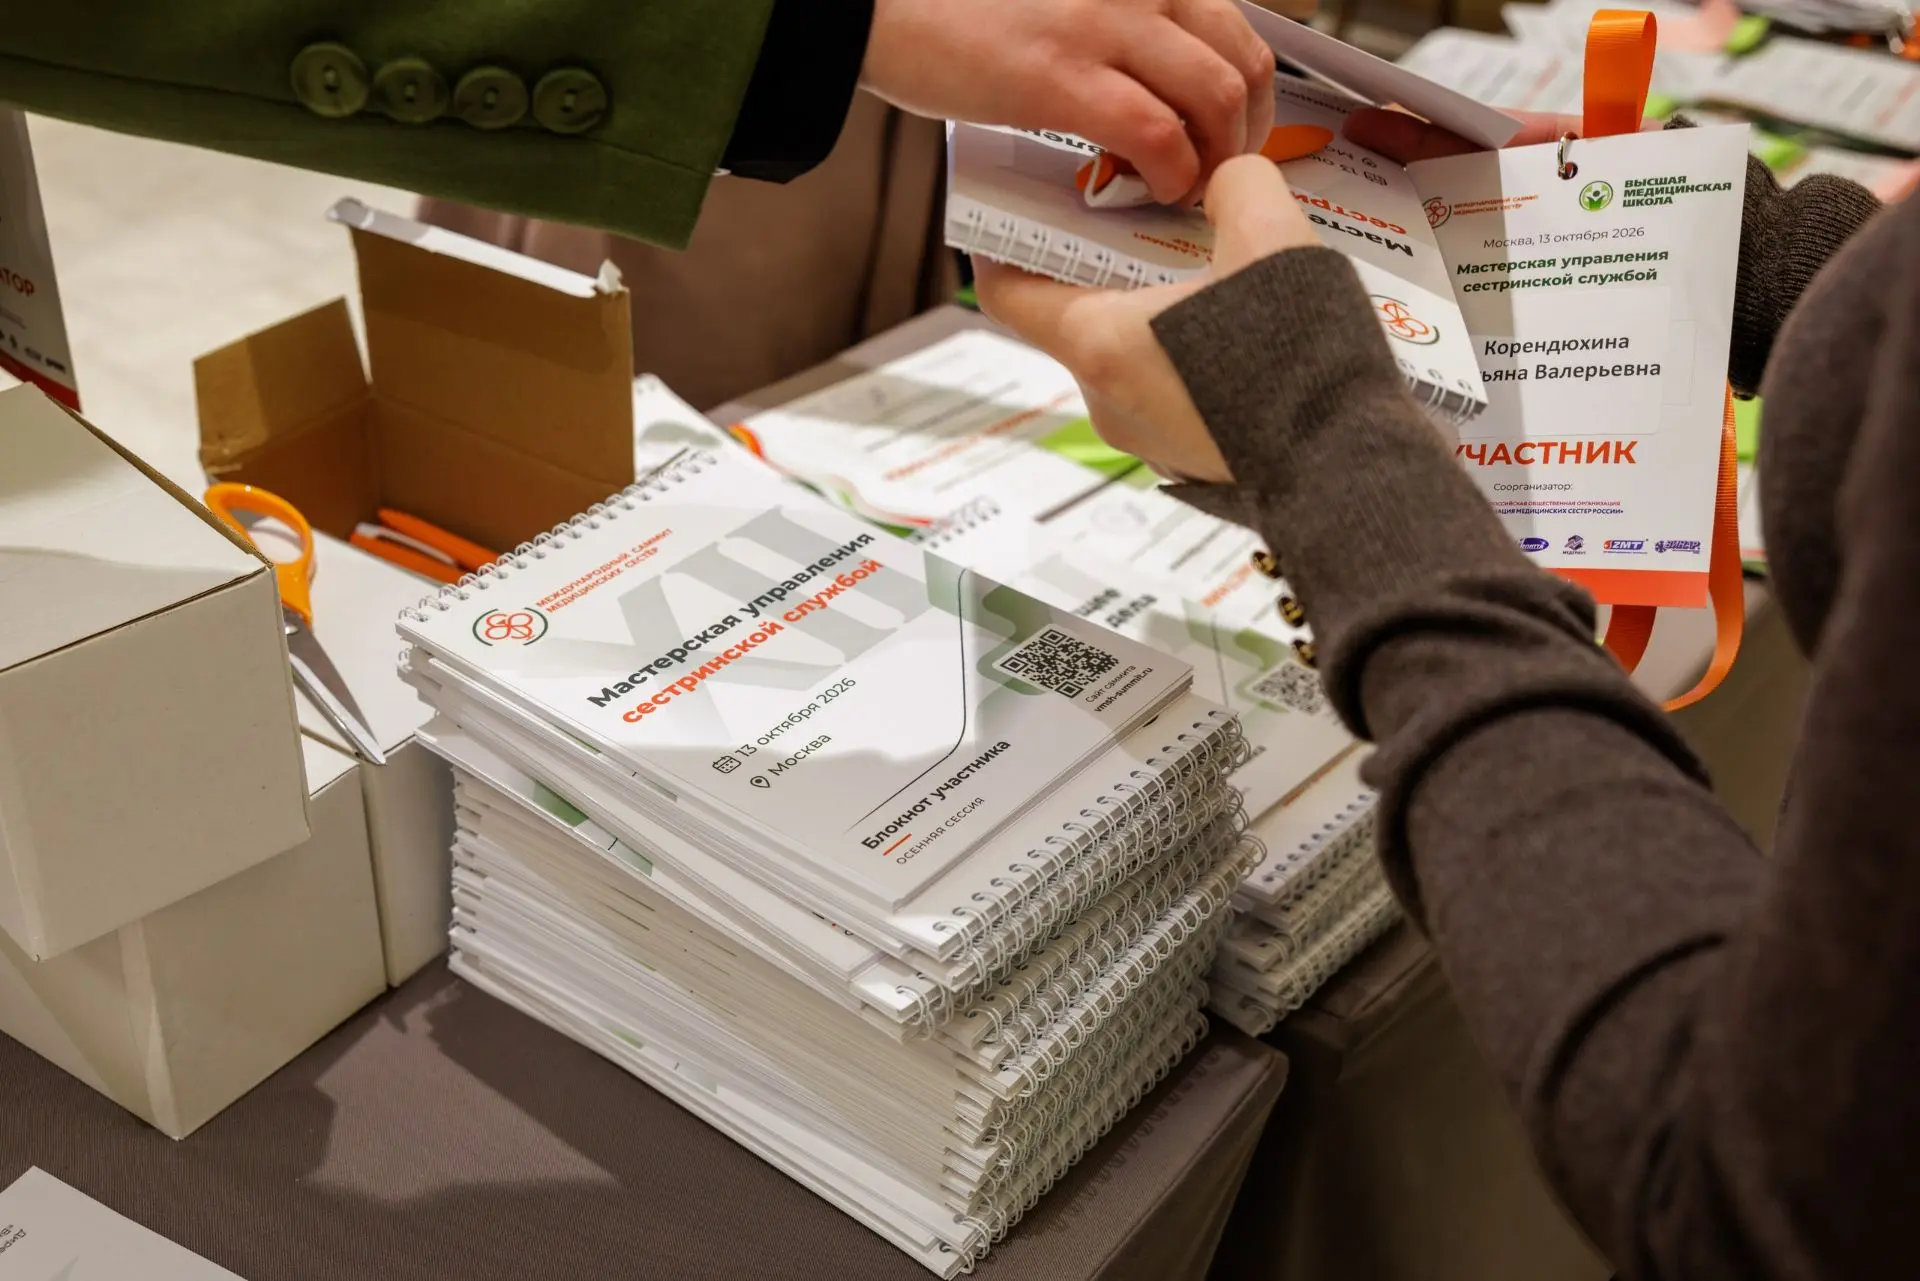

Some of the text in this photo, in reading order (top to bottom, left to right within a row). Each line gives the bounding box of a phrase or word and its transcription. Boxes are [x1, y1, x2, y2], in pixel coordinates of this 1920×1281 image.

[1623, 182, 1732, 198] МЕДИЦИНСКАЯ
[1624, 175, 1687, 188] ВЫСШАЯ
[1290, 190, 1407, 235] сестри
[1622, 196, 1674, 208] ШКОЛА
[1307, 213, 1414, 257] Масте
[1483, 226, 1645, 249] Москва, 13 октября 2026
[1456, 250, 1669, 275] Мастерская управления
[1463, 268, 1658, 293] сестринской службой
[1484, 336, 1630, 358] Корендюхина
[1479, 363, 1661, 382] ьяна Валерьевна
[1493, 483, 1574, 493] Соорганизатор:
[1612, 541, 1643, 549] ZMT
[536, 527, 673, 607] МЕЖДУНАРОДНЫЙ САММИТ
[545, 566, 624, 613] МЕДИЦИНСКИХ
[586, 531, 876, 708] Мастерская управления
[622, 558, 885, 724] сестринской службой
[1085, 665, 1137, 703] Сайт саммита
[1094, 667, 1153, 712] vmsh-summit.ru
[734, 677, 857, 757] 13 октября 2026
[767, 734, 833, 777] Москва
[861, 740, 1012, 850] Блокнот участника
[896, 796, 986, 865] ОСЕННЯЯ СЕССИЯ
